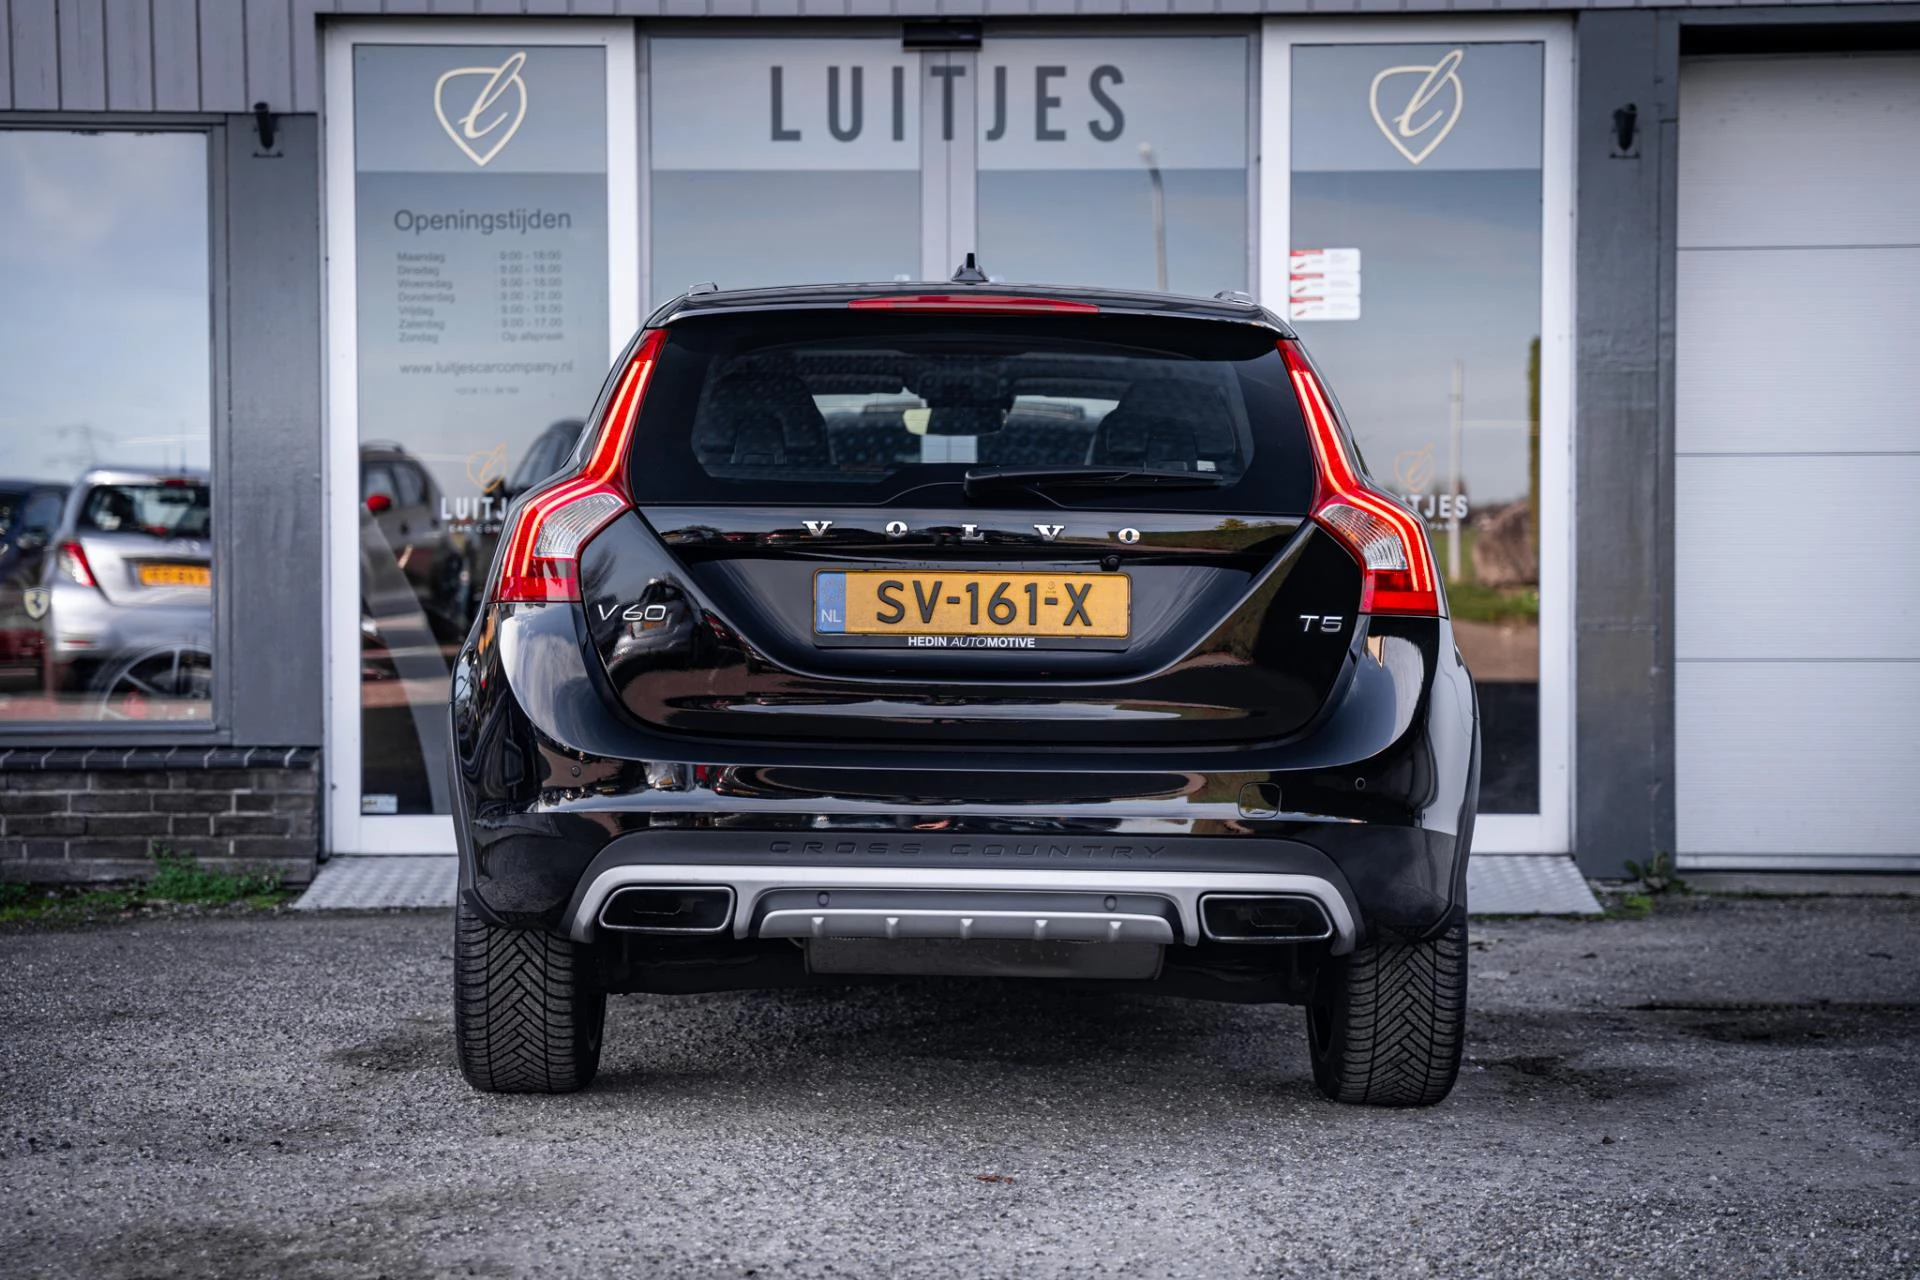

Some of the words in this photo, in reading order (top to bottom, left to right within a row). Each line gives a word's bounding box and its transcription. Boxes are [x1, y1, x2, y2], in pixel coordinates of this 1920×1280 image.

[770, 64, 1125, 142] LUITJES
[394, 208, 572, 236] Openingstijden
[441, 497, 507, 520] LUITJ
[803, 521, 1140, 544] VOLVO
[598, 604, 666, 621] V60
[876, 580, 1092, 627] SV-161-X
[821, 608, 841, 623] NL
[1300, 615, 1343, 632] T5
[908, 636, 947, 647] HEDIN
[950, 637, 1036, 648] AUTOMOTIVE
[769, 840, 923, 855] CROSS
[950, 843, 1166, 859] COUNTRY
